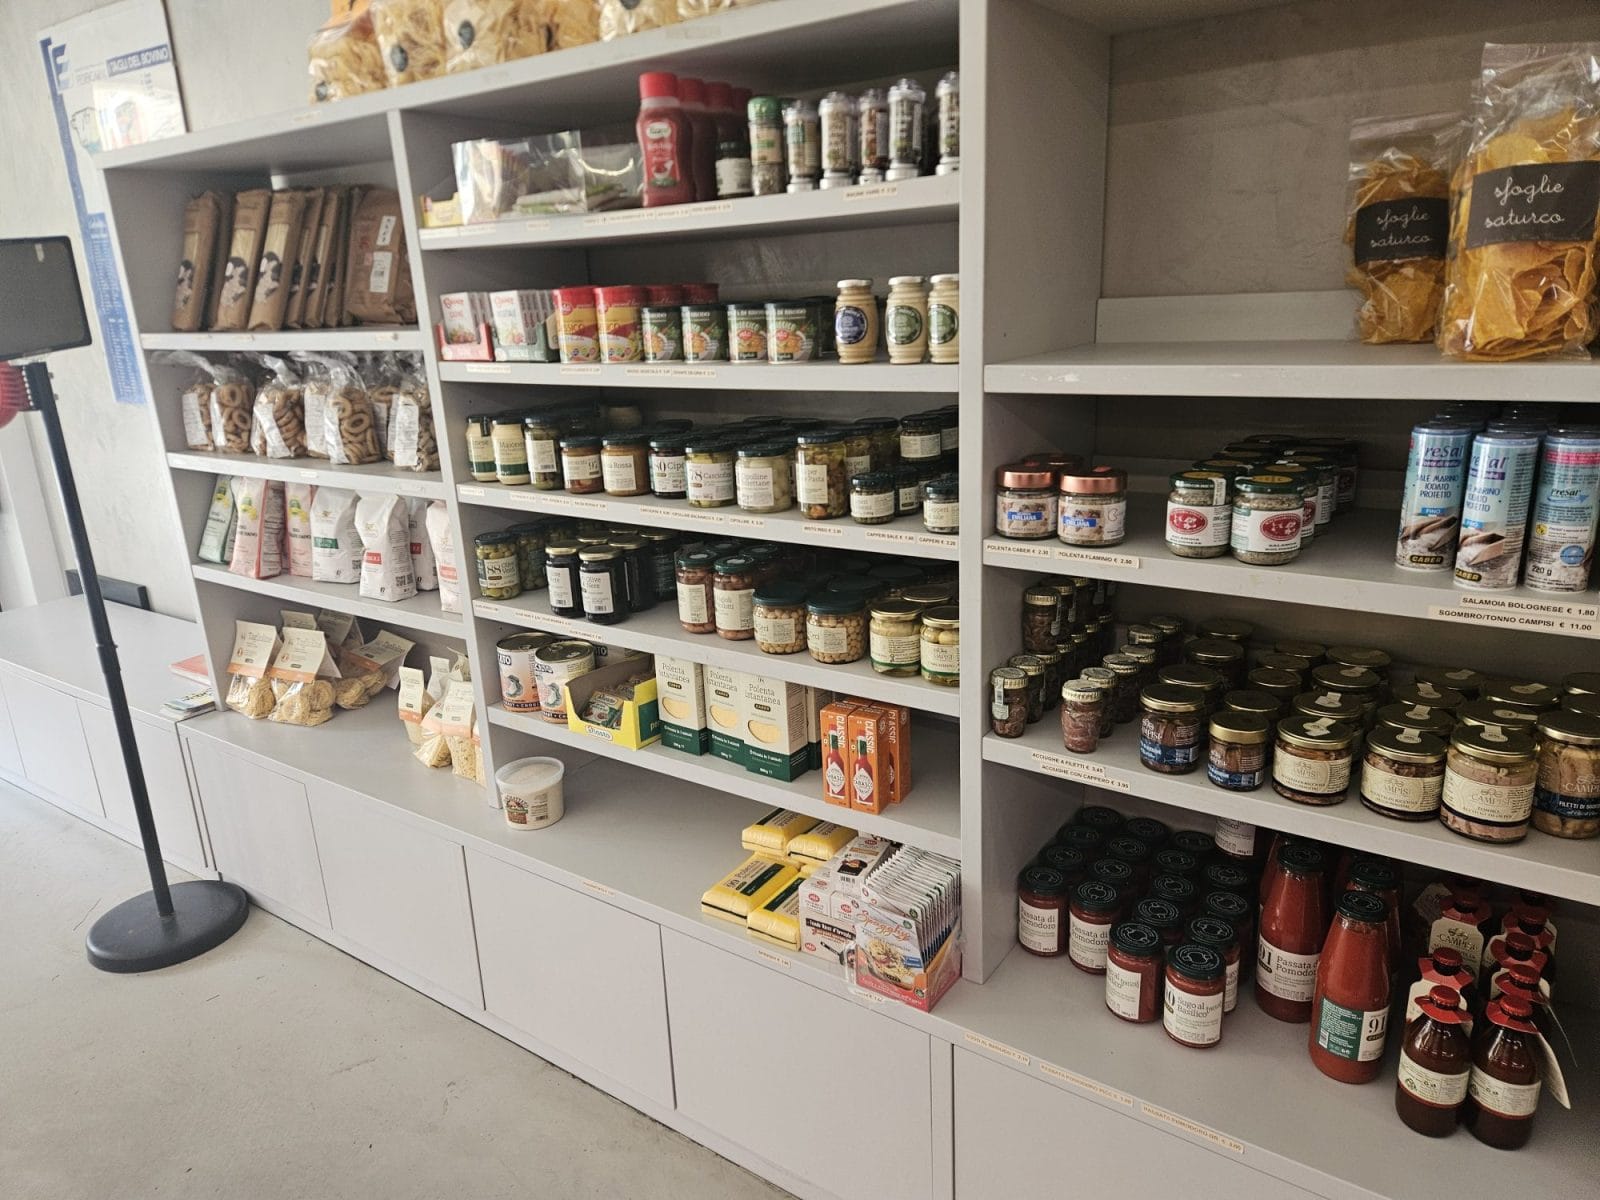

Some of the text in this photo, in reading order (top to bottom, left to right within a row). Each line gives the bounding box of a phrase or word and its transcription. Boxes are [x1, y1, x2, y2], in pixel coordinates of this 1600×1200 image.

[1494, 174, 1564, 205] sfoglie
[1376, 206, 1430, 230] sfoglie
[1485, 208, 1565, 228] saturco
[1370, 233, 1432, 248] saturco
[1420, 490, 1452, 498] PROTETTO
[987, 545, 1011, 553] POLENTA
[1059, 551, 1085, 560] POLENTA
[486, 564, 502, 575] 88
[1532, 565, 1544, 574] 220
[1462, 597, 1506, 607] SALAMOIA
[1508, 602, 1564, 613] BOLOGNESE
[1439, 609, 1516, 623] SGOMBRO/TONNO
[1518, 617, 1554, 627] CAMPISI
[662, 662, 685, 675] Polenta
[659, 670, 690, 684] istantanea
[709, 670, 733, 683] Polenta
[706, 678, 738, 692] istantanea
[749, 684, 775, 696] Polenta
[744, 691, 781, 706] istantanea
[836, 716, 845, 748] CLASSIC
[865, 720, 874, 754] CLASSIC
[1032, 753, 1059, 763] ACCIUGHE
[1065, 761, 1084, 769] FILETTI
[1042, 764, 1069, 775] ACCIUGHE
[1559, 801, 1579, 809] FILETTI
[1072, 924, 1108, 938] Passata di
[1277, 956, 1312, 968] Passata
[1276, 963, 1316, 976] Pomodo
[1177, 997, 1197, 1009] Sugo
[1199, 1001, 1205, 1009] al
[1369, 1016, 1386, 1033] 91
